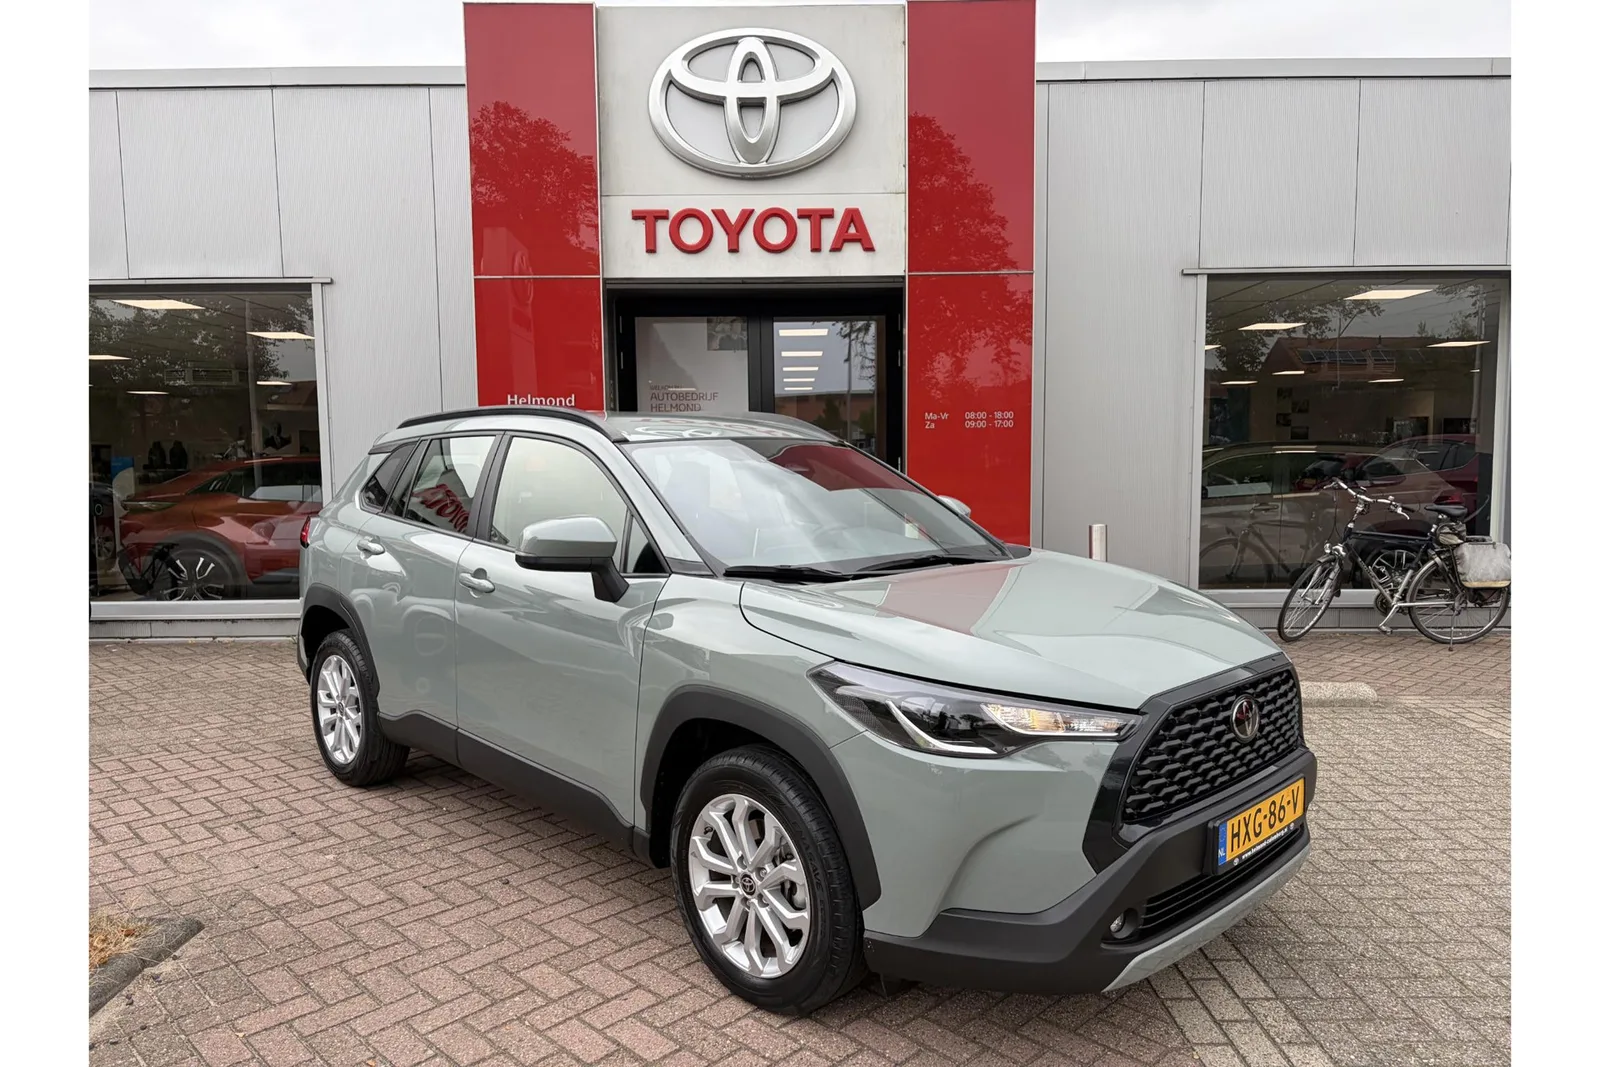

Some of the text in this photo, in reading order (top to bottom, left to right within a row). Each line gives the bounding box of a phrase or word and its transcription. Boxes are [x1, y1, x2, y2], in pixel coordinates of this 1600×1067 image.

[632, 207, 876, 254] TOYOTA
[507, 393, 575, 407] Helmond
[650, 391, 719, 402] AUTOBEDRIJF
[650, 402, 702, 413] HELMOND
[924, 411, 949, 420] Ma-Vr
[964, 411, 987, 420] 08:00
[993, 410, 1014, 419] 18:00
[924, 421, 935, 429] Za
[964, 420, 987, 429] 09:00
[993, 420, 1014, 428] 17:00
[1230, 785, 1300, 853] HXG-86-V
[1217, 847, 1226, 858] NL
